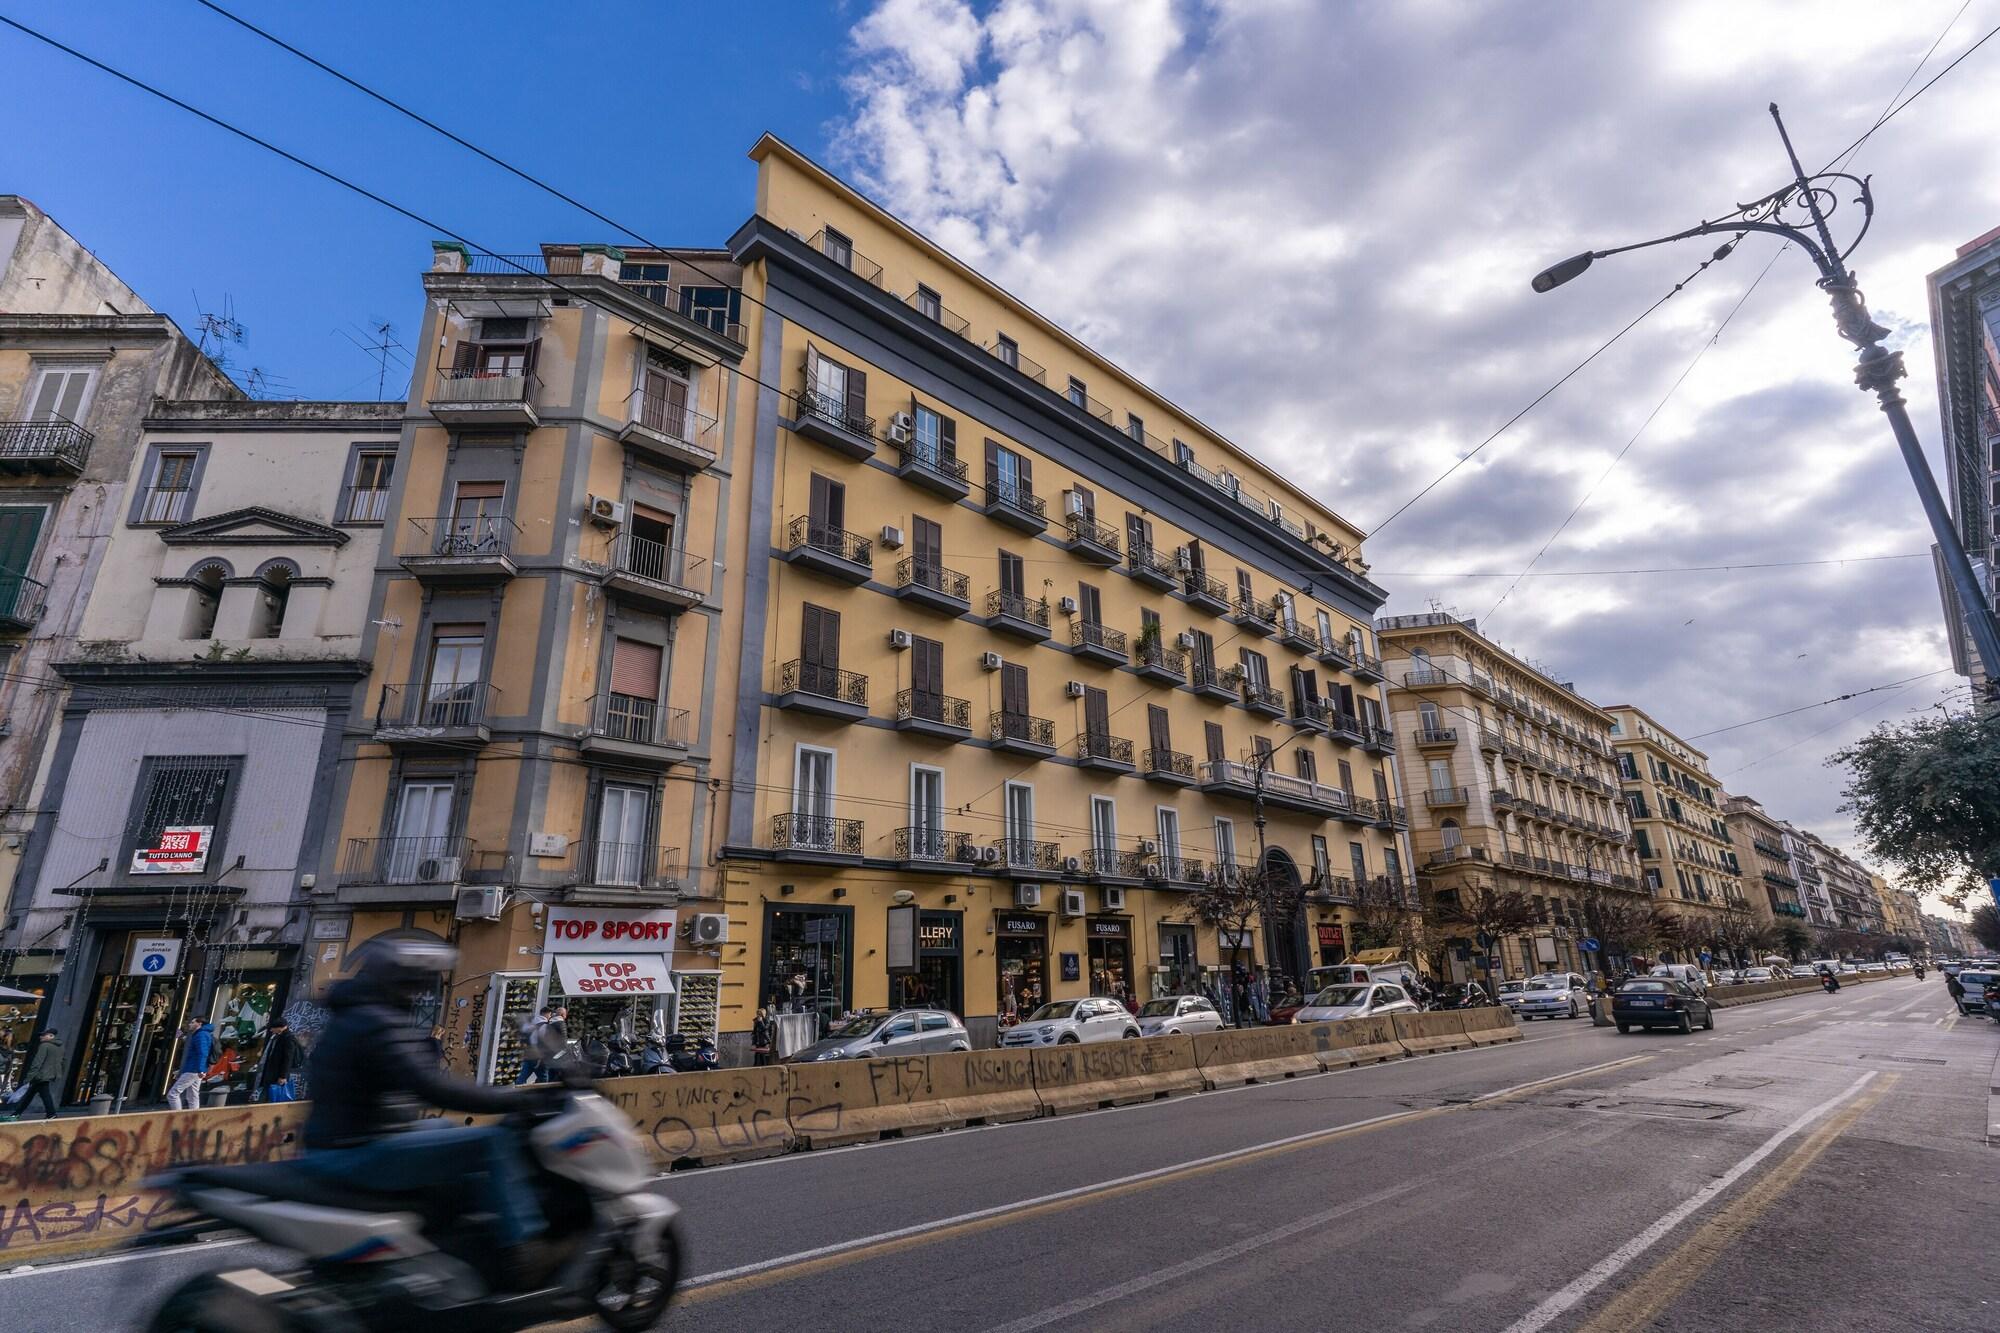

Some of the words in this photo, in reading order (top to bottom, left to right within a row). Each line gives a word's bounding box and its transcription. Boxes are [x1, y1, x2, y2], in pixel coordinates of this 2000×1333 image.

[552, 920, 598, 939] TOP
[602, 921, 672, 940] SPORT
[1007, 921, 1036, 930] FUSARO
[1096, 924, 1120, 932] FUSARO
[920, 927, 953, 938] LLERY
[1318, 927, 1342, 939] OUTLET
[589, 963, 637, 977] TOP
[578, 977, 656, 992] SPORT
[651, 1091, 667, 1109] SI
[676, 1086, 721, 1110] VINCE
